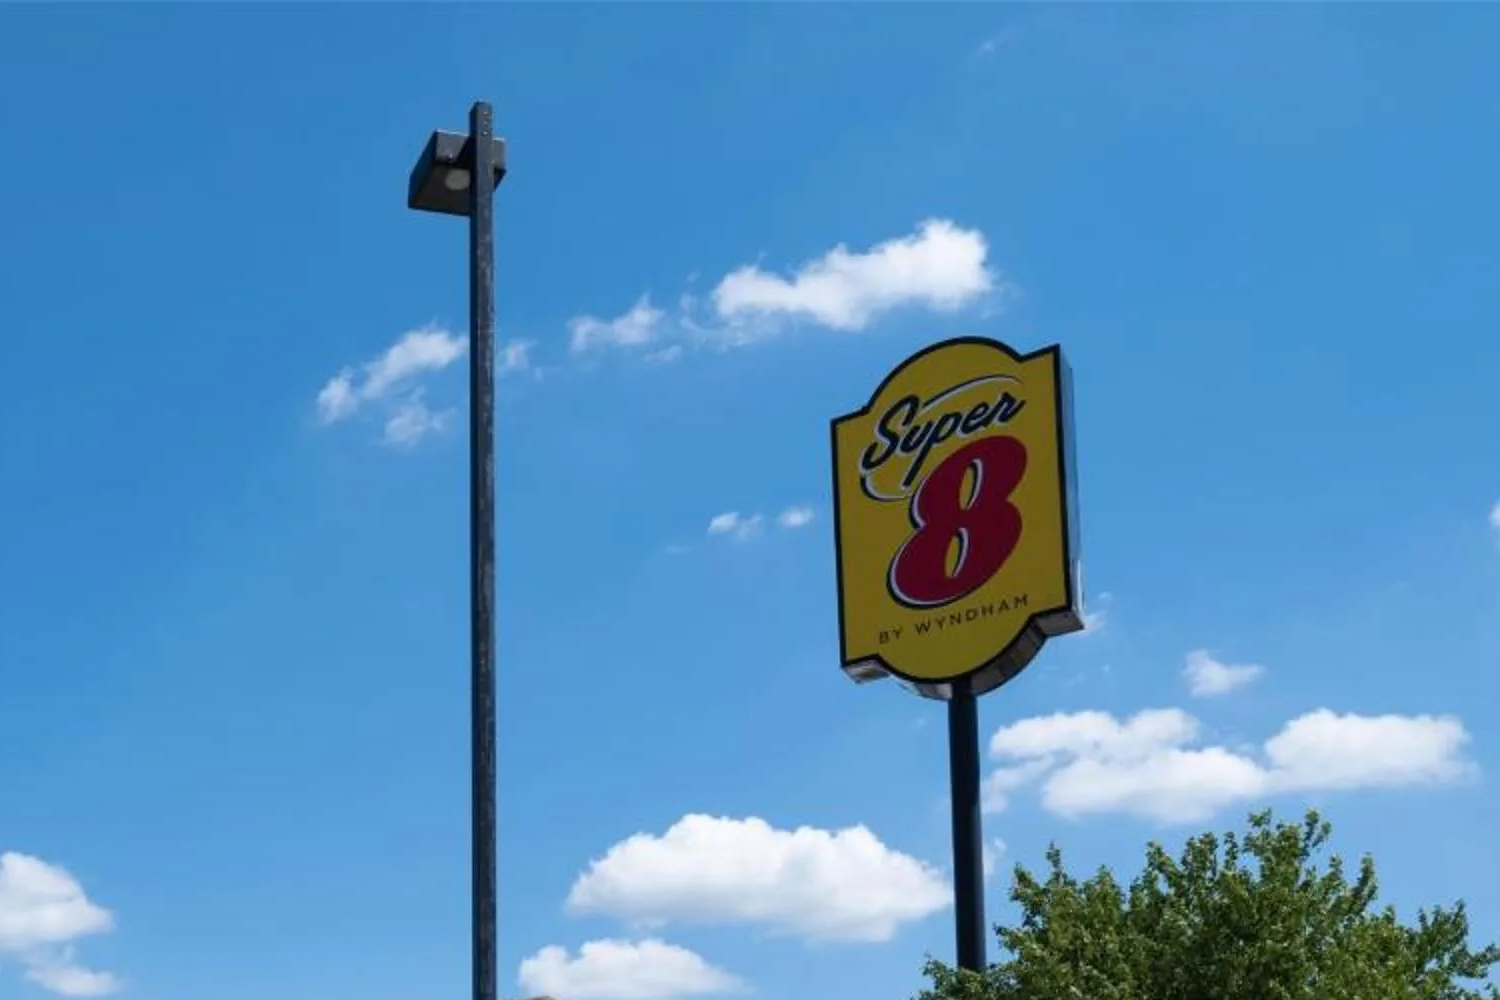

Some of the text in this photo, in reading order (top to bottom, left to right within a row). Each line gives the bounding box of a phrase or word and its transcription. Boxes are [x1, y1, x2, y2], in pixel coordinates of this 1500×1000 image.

[861, 391, 1026, 489] Super
[886, 435, 1028, 609] 8
[878, 594, 1029, 644] BY WYNDHAM
